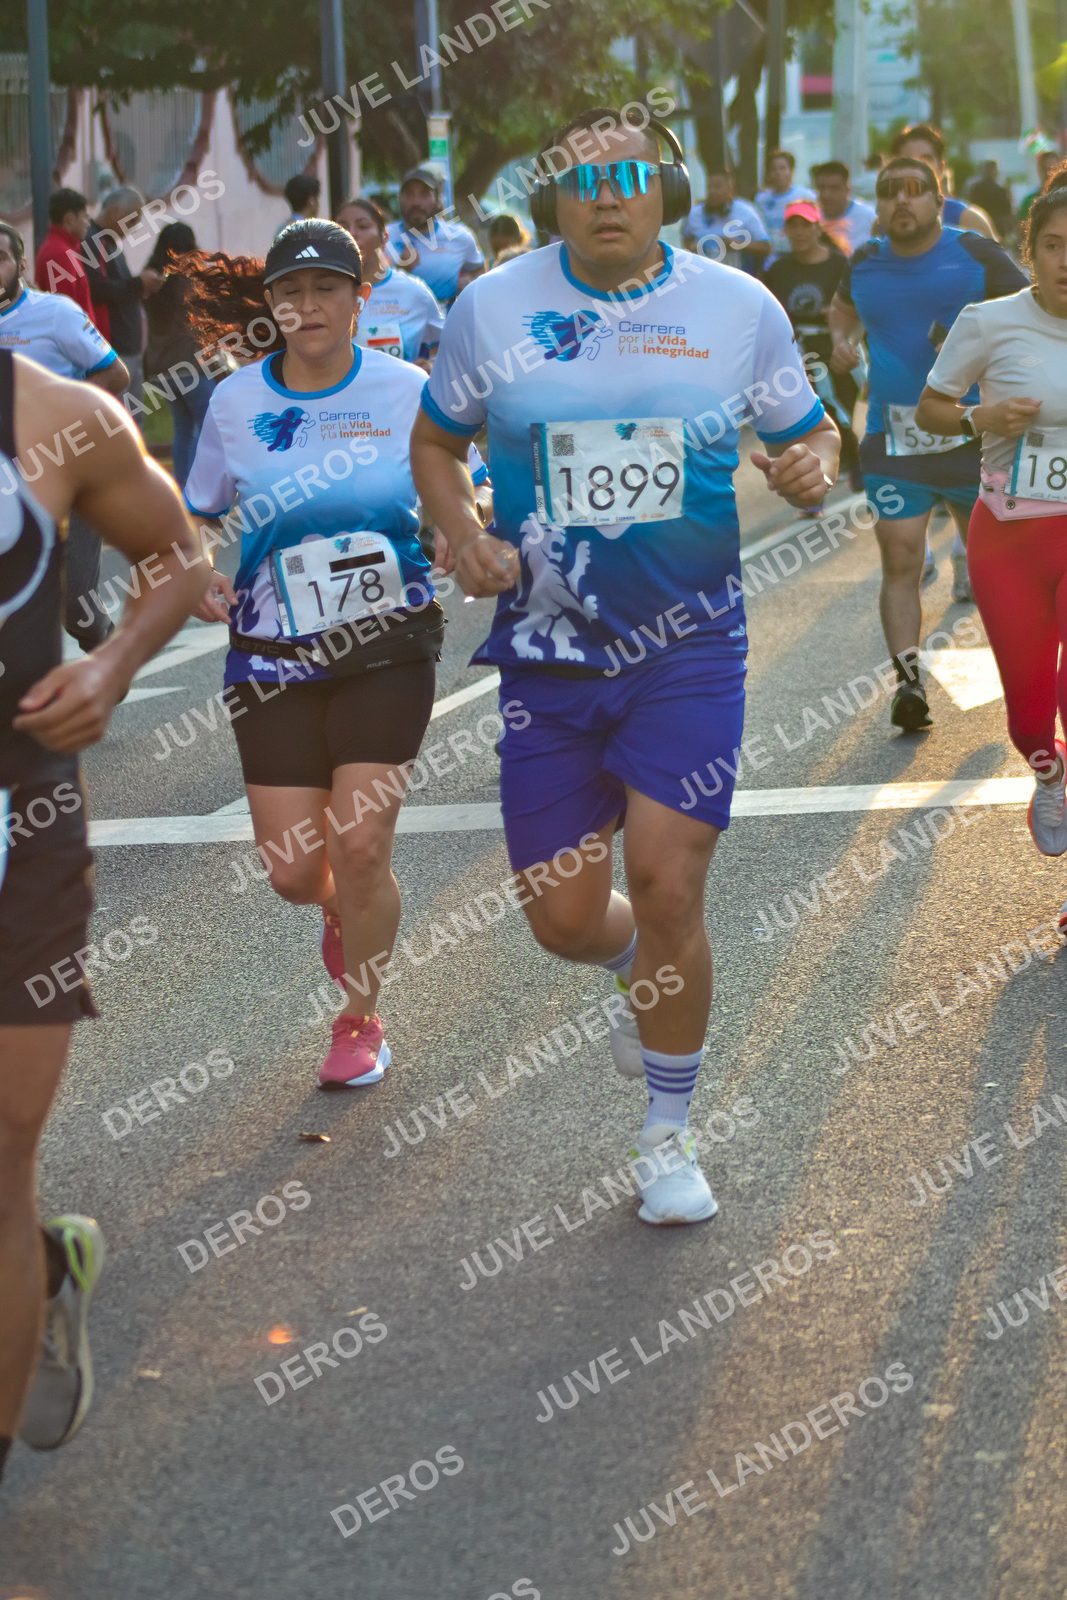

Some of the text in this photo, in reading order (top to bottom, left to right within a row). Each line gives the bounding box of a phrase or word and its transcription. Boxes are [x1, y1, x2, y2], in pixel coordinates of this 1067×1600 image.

[618, 320, 686, 335] Carrera
[618, 334, 687, 346] por la Vida
[618, 343, 709, 359] y la Integridad
[319, 411, 370, 422] Carrera
[320, 420, 372, 432] por la Vida
[321, 428, 391, 441] y la Integridad
[1027, 454, 1067, 491] 18
[558, 461, 680, 511] 1899
[308, 568, 385, 617] 178
